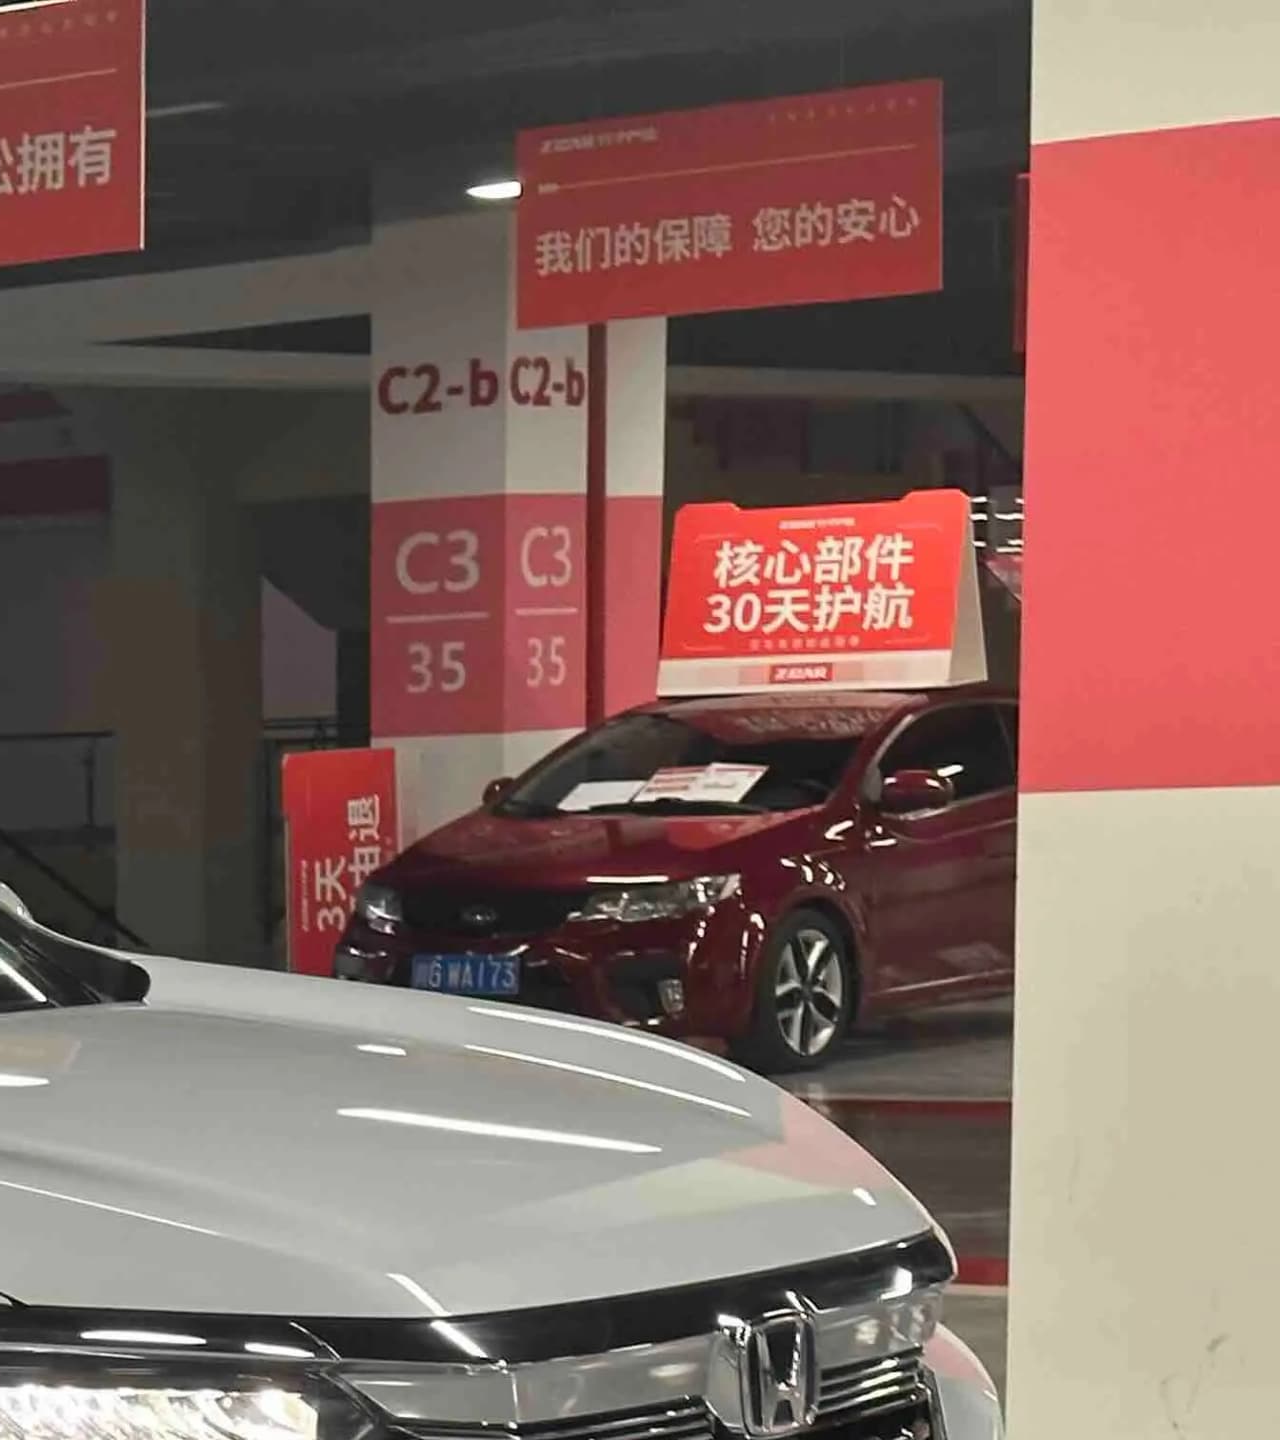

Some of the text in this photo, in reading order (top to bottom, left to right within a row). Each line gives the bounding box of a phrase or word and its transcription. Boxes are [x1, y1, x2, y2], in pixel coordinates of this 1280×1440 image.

[535, 194, 920, 276] 我们的保障 您的安心
[377, 358, 500, 415] C2-b
[510, 355, 585, 407] C2-b
[395, 529, 481, 595] C3
[520, 526, 573, 588] C3
[714, 532, 915, 589] 核心部件
[703, 583, 915, 634] 30天护航
[406, 641, 467, 694] 35
[526, 636, 567, 688] 35
[347, 793, 381, 912] 由退
[315, 856, 346, 931] 3天
